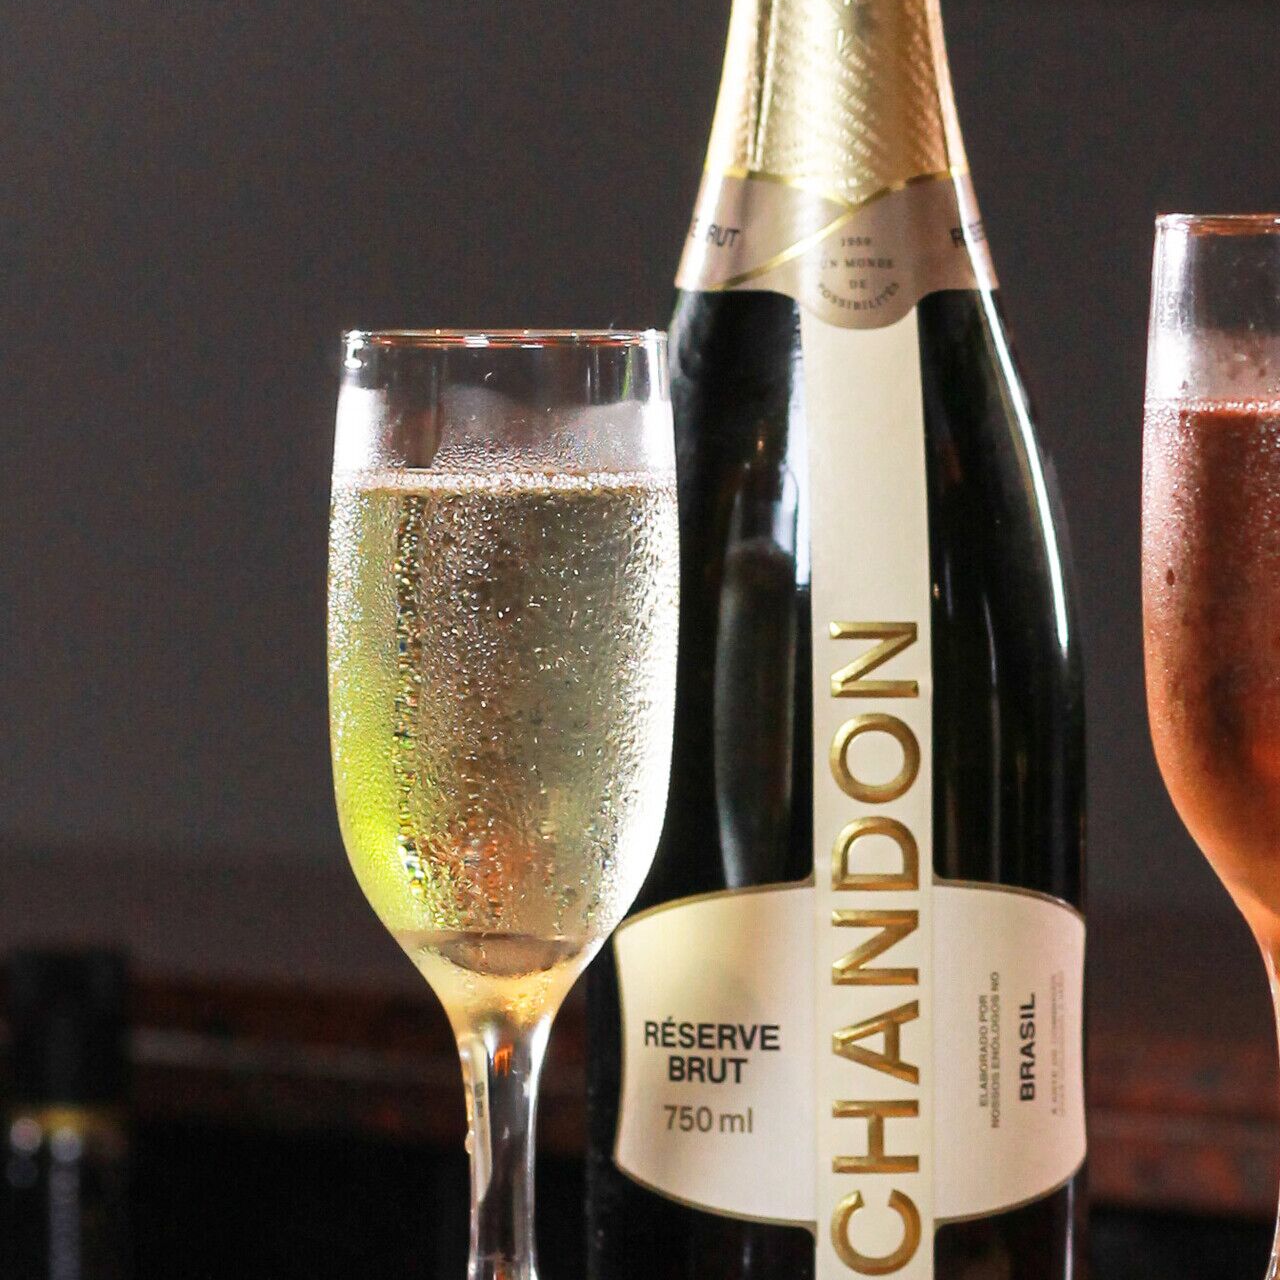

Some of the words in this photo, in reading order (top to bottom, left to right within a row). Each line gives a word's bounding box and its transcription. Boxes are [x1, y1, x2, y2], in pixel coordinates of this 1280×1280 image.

[829, 620, 922, 1277] CHANDON
[990, 971, 1001, 992] NO
[978, 995, 989, 1022] POR
[644, 1016, 781, 1051] RÉSERVE
[1019, 992, 1036, 1101] BRASIL
[668, 1055, 748, 1084] BRUT
[978, 1025, 989, 1107] ELABORADO
[990, 1072, 1001, 1128] NOSSOS
[663, 1104, 713, 1133] 750
[719, 1106, 753, 1134] ml
